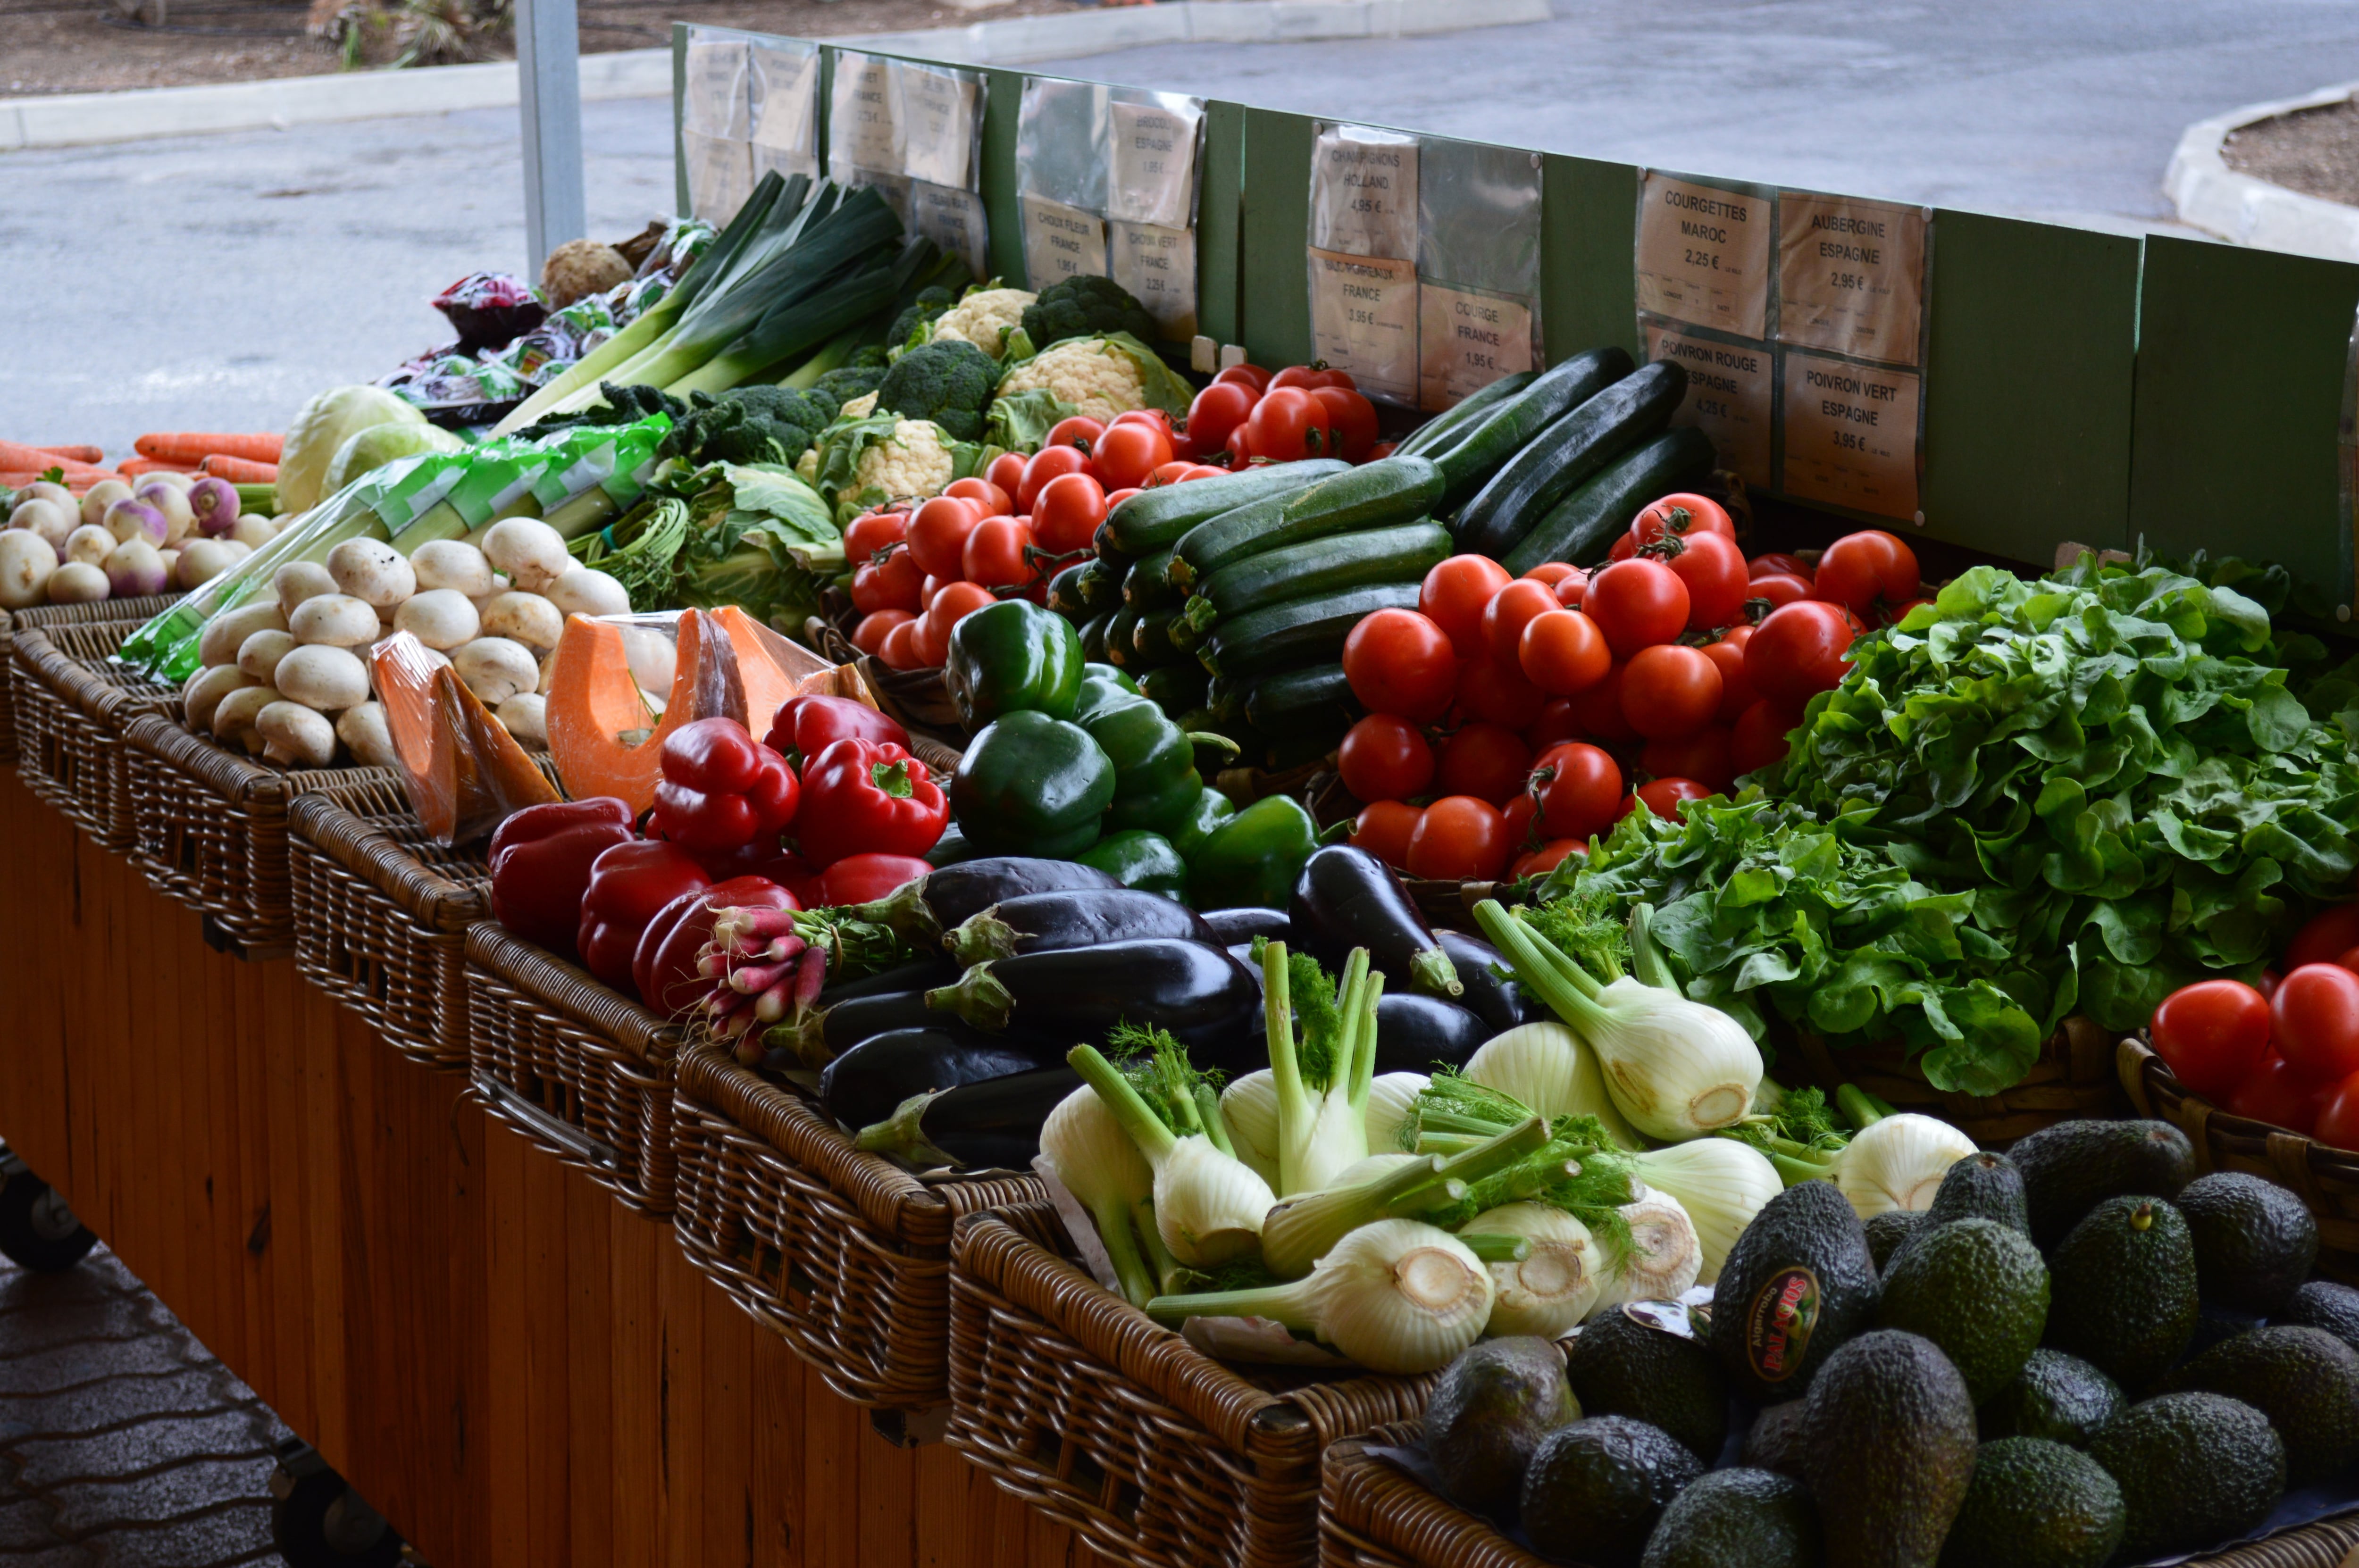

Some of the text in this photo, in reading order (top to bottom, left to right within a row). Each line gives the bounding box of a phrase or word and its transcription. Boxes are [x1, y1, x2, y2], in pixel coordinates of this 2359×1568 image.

[1136, 137, 1173, 153] ESPAGNE
[1351, 198, 1381, 214] 4,95 €
[1665, 190, 1747, 222] COURGETTES
[1681, 220, 1726, 244] MAROC
[1812, 214, 1885, 238] AUBERGINE
[1050, 235, 1082, 255] FRANCE
[1157, 235, 1177, 250] VERT
[1140, 254, 1169, 271] FRANCE
[1685, 249, 1709, 267] 2,25
[1712, 255, 1719, 270] €
[1819, 242, 1880, 265] ESPAGNE
[1831, 272, 1855, 290] 2,95
[1857, 275, 1864, 291] €
[1343, 284, 1381, 302] FRANCE
[1349, 309, 1374, 325] 3,95 €
[1456, 301, 1499, 324] COURGE
[1457, 325, 1500, 347] FRANCE
[1466, 351, 1486, 367] 1,95
[1487, 357, 1495, 370] €
[1662, 339, 1758, 373] POIVRON ROUGE
[1687, 370, 1738, 394] ESPAGNE
[1807, 370, 1897, 402] POIVRON VERT
[1696, 398, 1718, 416] 4,25
[1721, 403, 1727, 418] €
[1822, 400, 1879, 426] ESPAGNE
[1833, 431, 1856, 449] 3,95
[1858, 436, 1865, 452] €
[1752, 1287, 1778, 1348] Algarrobo
[1763, 1275, 1807, 1372] PALACIOS
